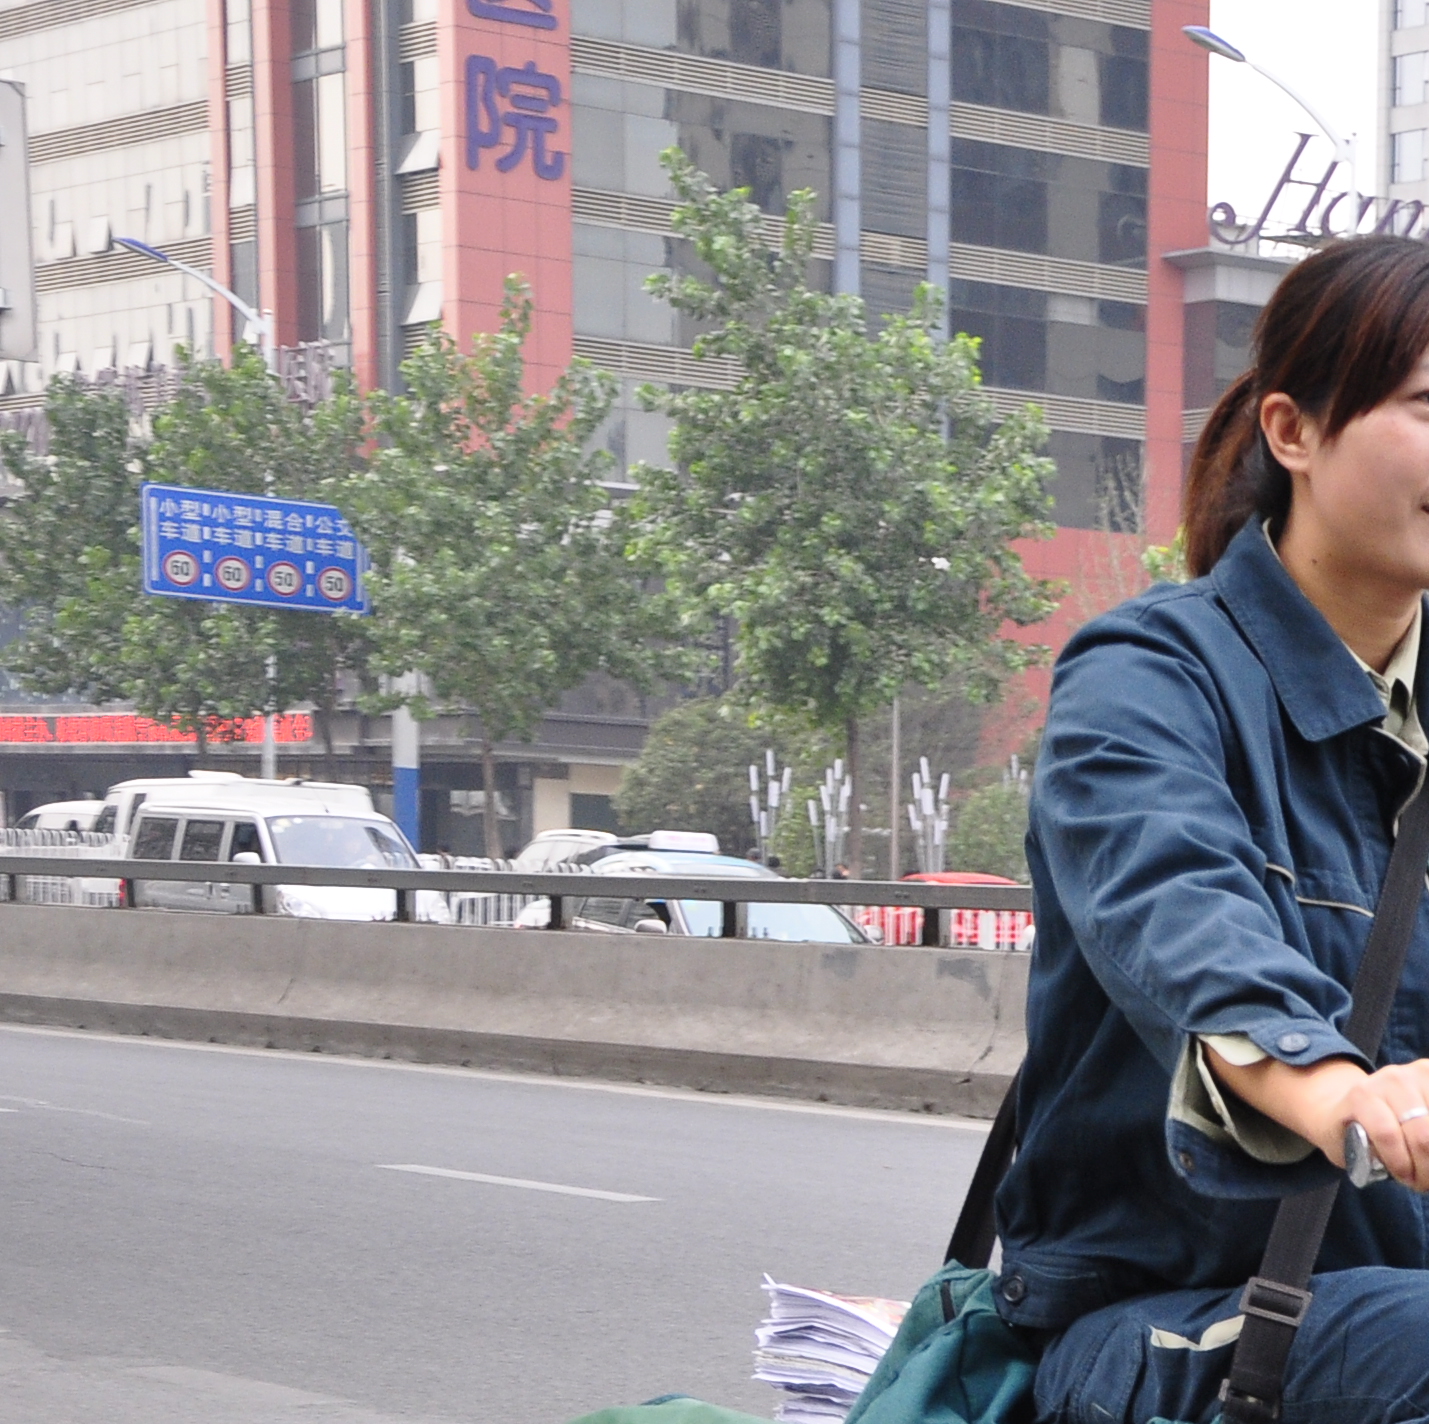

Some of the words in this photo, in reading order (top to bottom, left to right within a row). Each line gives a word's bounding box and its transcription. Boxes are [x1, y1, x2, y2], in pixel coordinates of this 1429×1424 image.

[466, 0, 563, 180] 院
[160, 498, 202, 520] 小型
[212, 504, 255, 527] 小型
[264, 509, 304, 532] 混合
[160, 521, 202, 543] 车道
[213, 526, 255, 549] 车道
[264, 532, 305, 554] 车道
[315, 538, 354, 560] 车道
[170, 560, 190, 577] 60
[222, 566, 242, 583] 60
[273, 571, 293, 588] 50
[324, 576, 344, 593] 50
